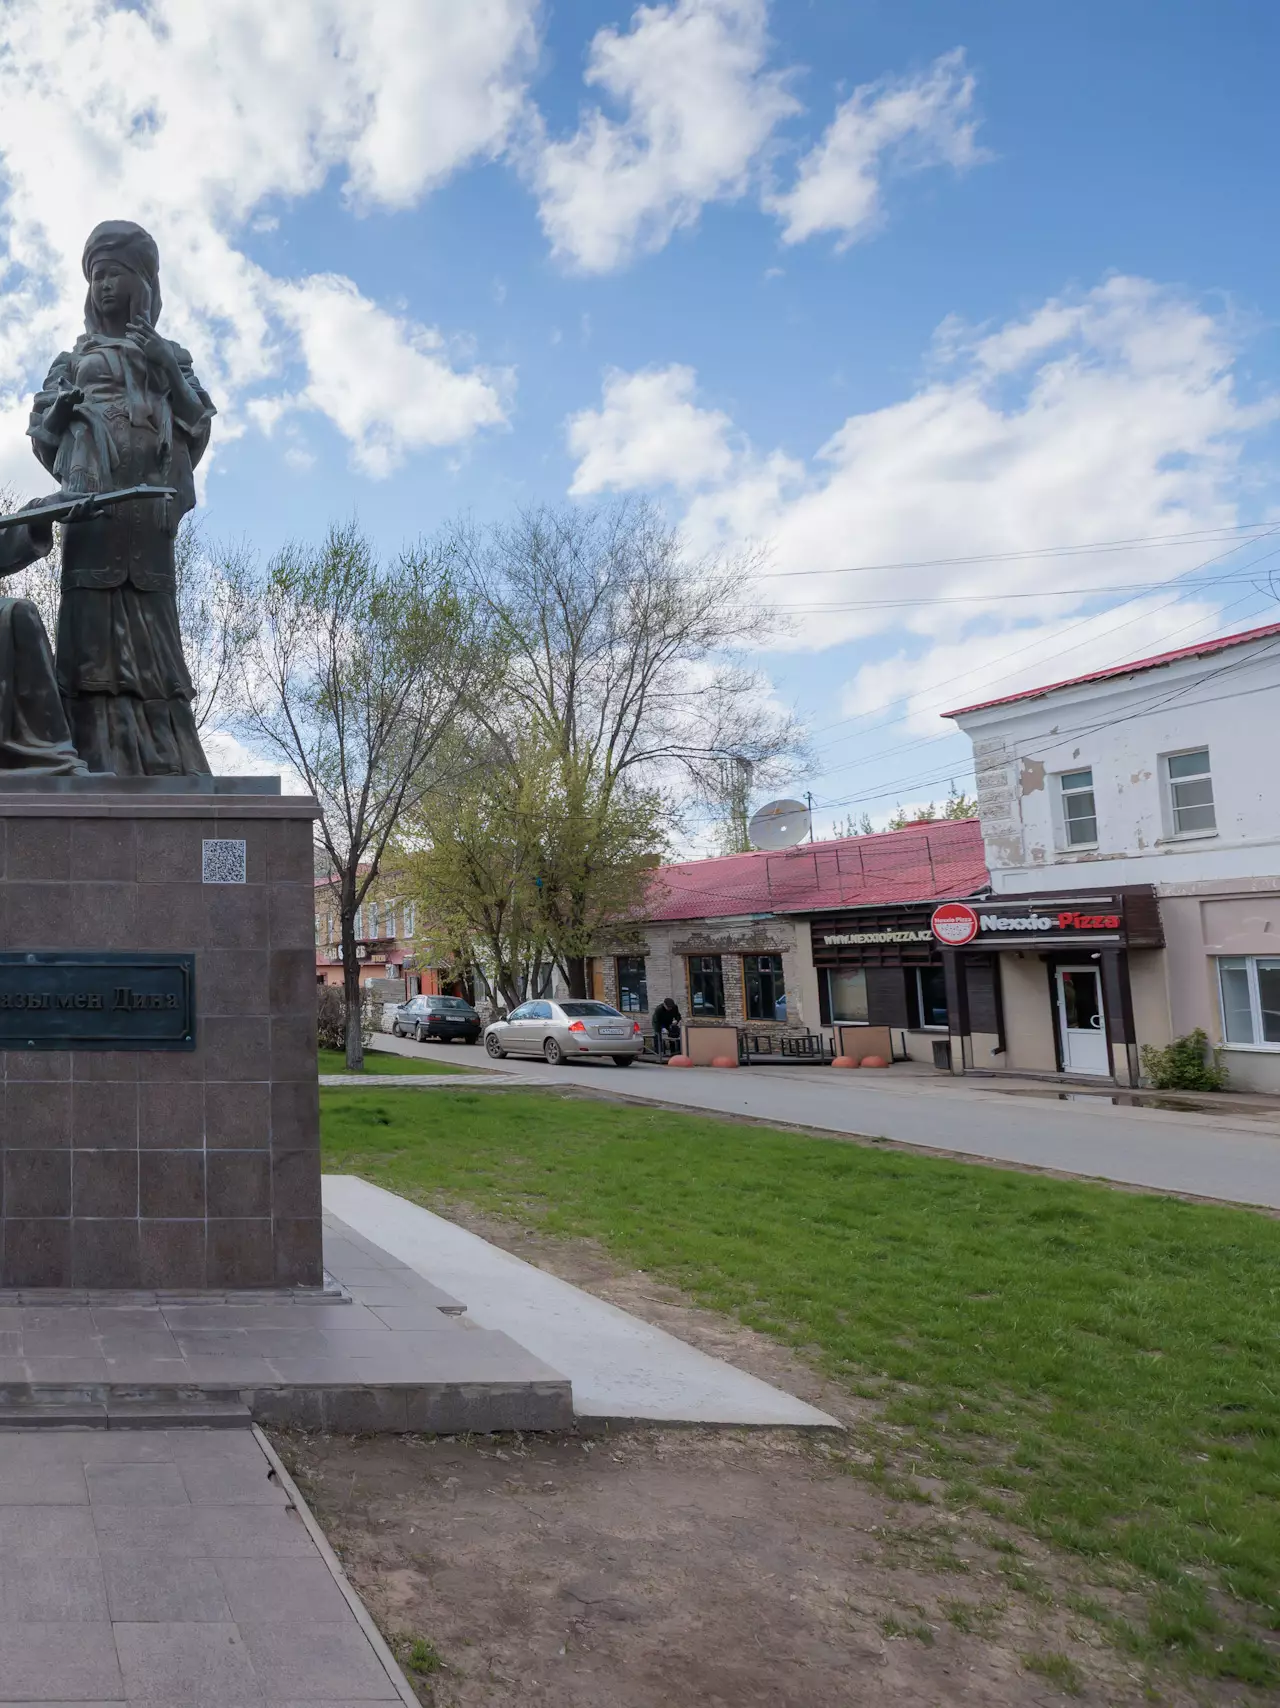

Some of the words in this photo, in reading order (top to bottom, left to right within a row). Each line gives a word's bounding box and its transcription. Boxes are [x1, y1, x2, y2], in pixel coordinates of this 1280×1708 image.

[980, 914, 1053, 931] Nexxio
[1057, 912, 1120, 929] Pizza
[55, 992, 106, 1010] мен
[111, 986, 181, 1013] Дина
